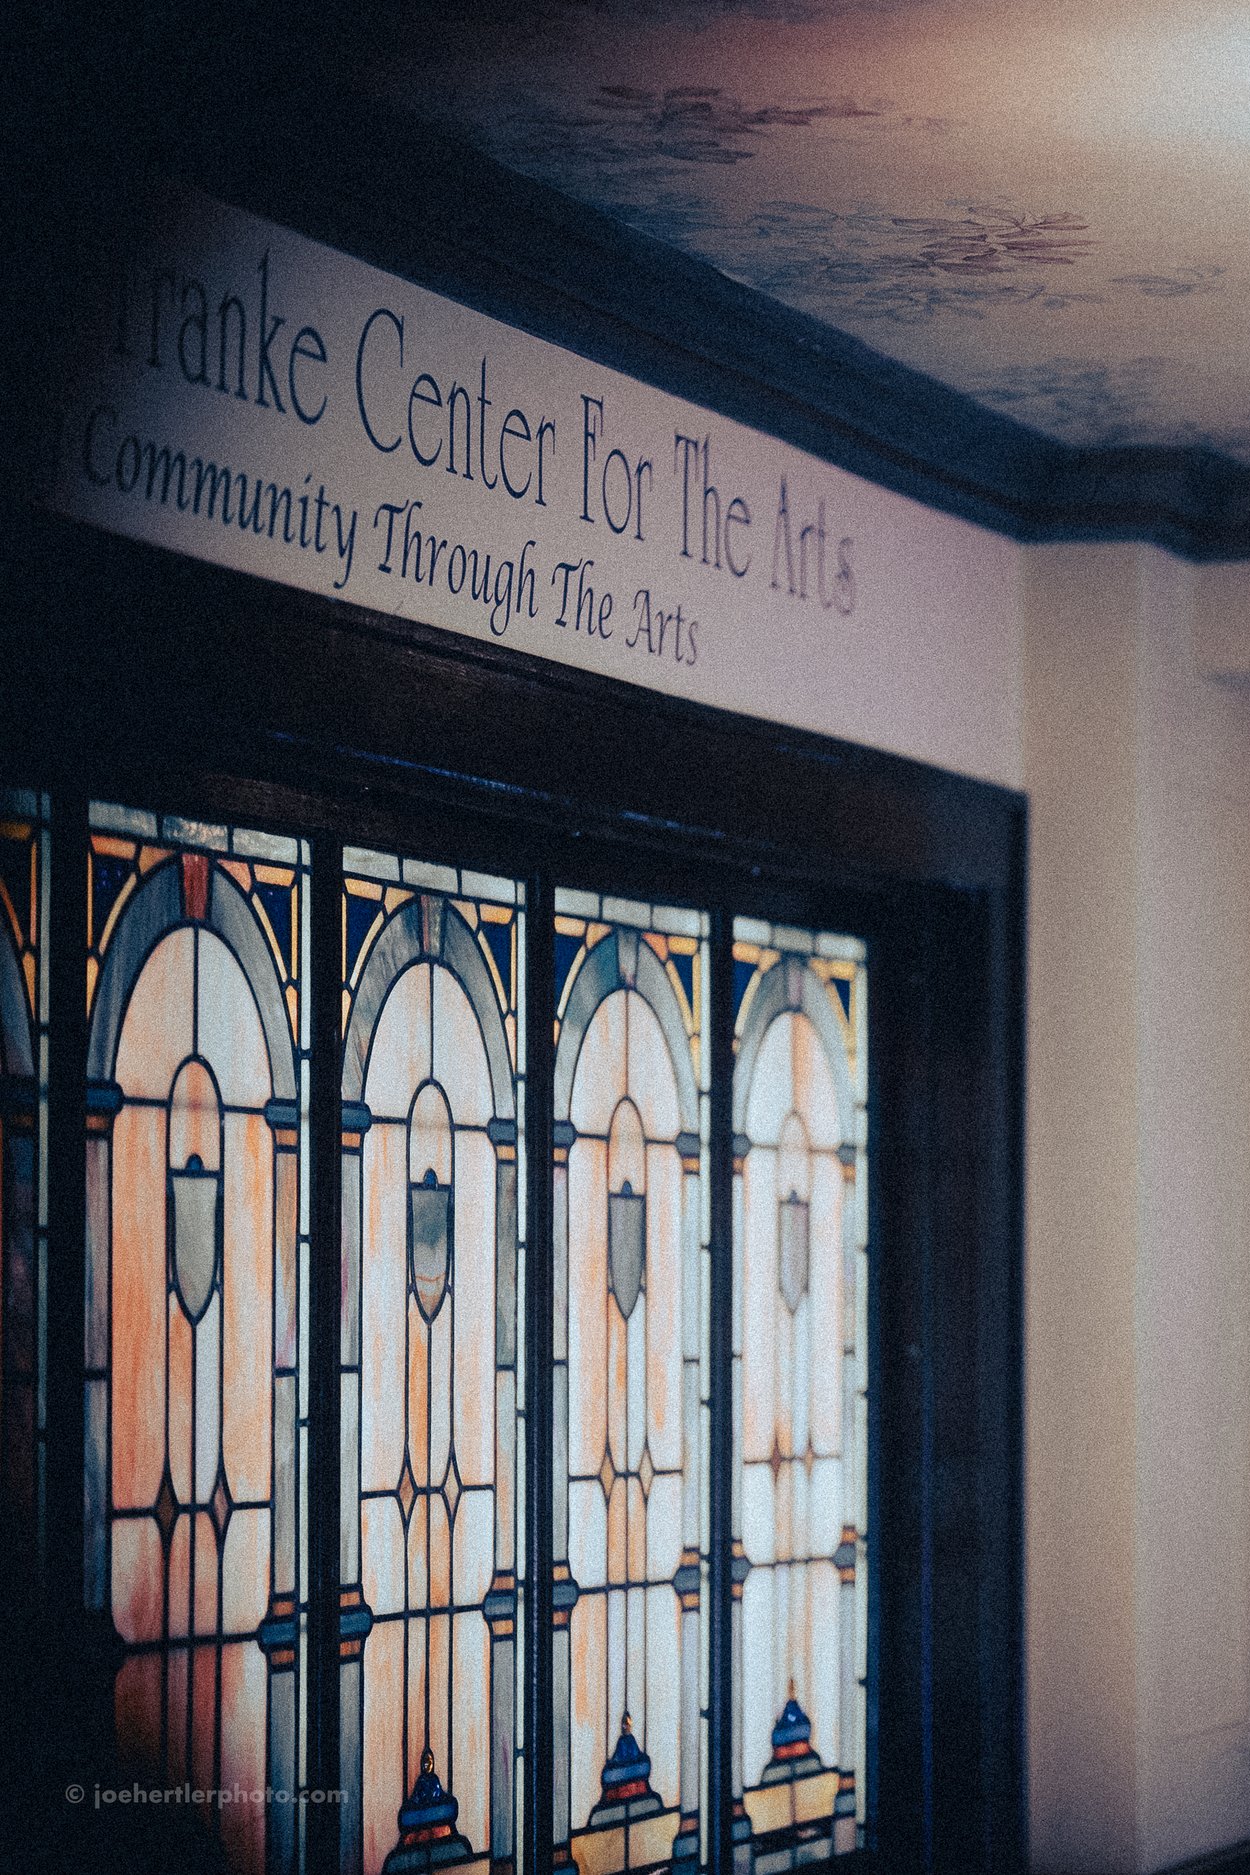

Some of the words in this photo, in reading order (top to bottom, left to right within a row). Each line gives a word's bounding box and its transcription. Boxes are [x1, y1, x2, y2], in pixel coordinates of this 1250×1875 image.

[82, 405, 358, 590] Community
[373, 499, 538, 637] Through
[551, 558, 614, 640] The
[626, 588, 701, 667] Arts
[355, 307, 555, 507] Center
[580, 393, 654, 541] For
[674, 430, 752, 578] The
[770, 474, 859, 616] Arts
